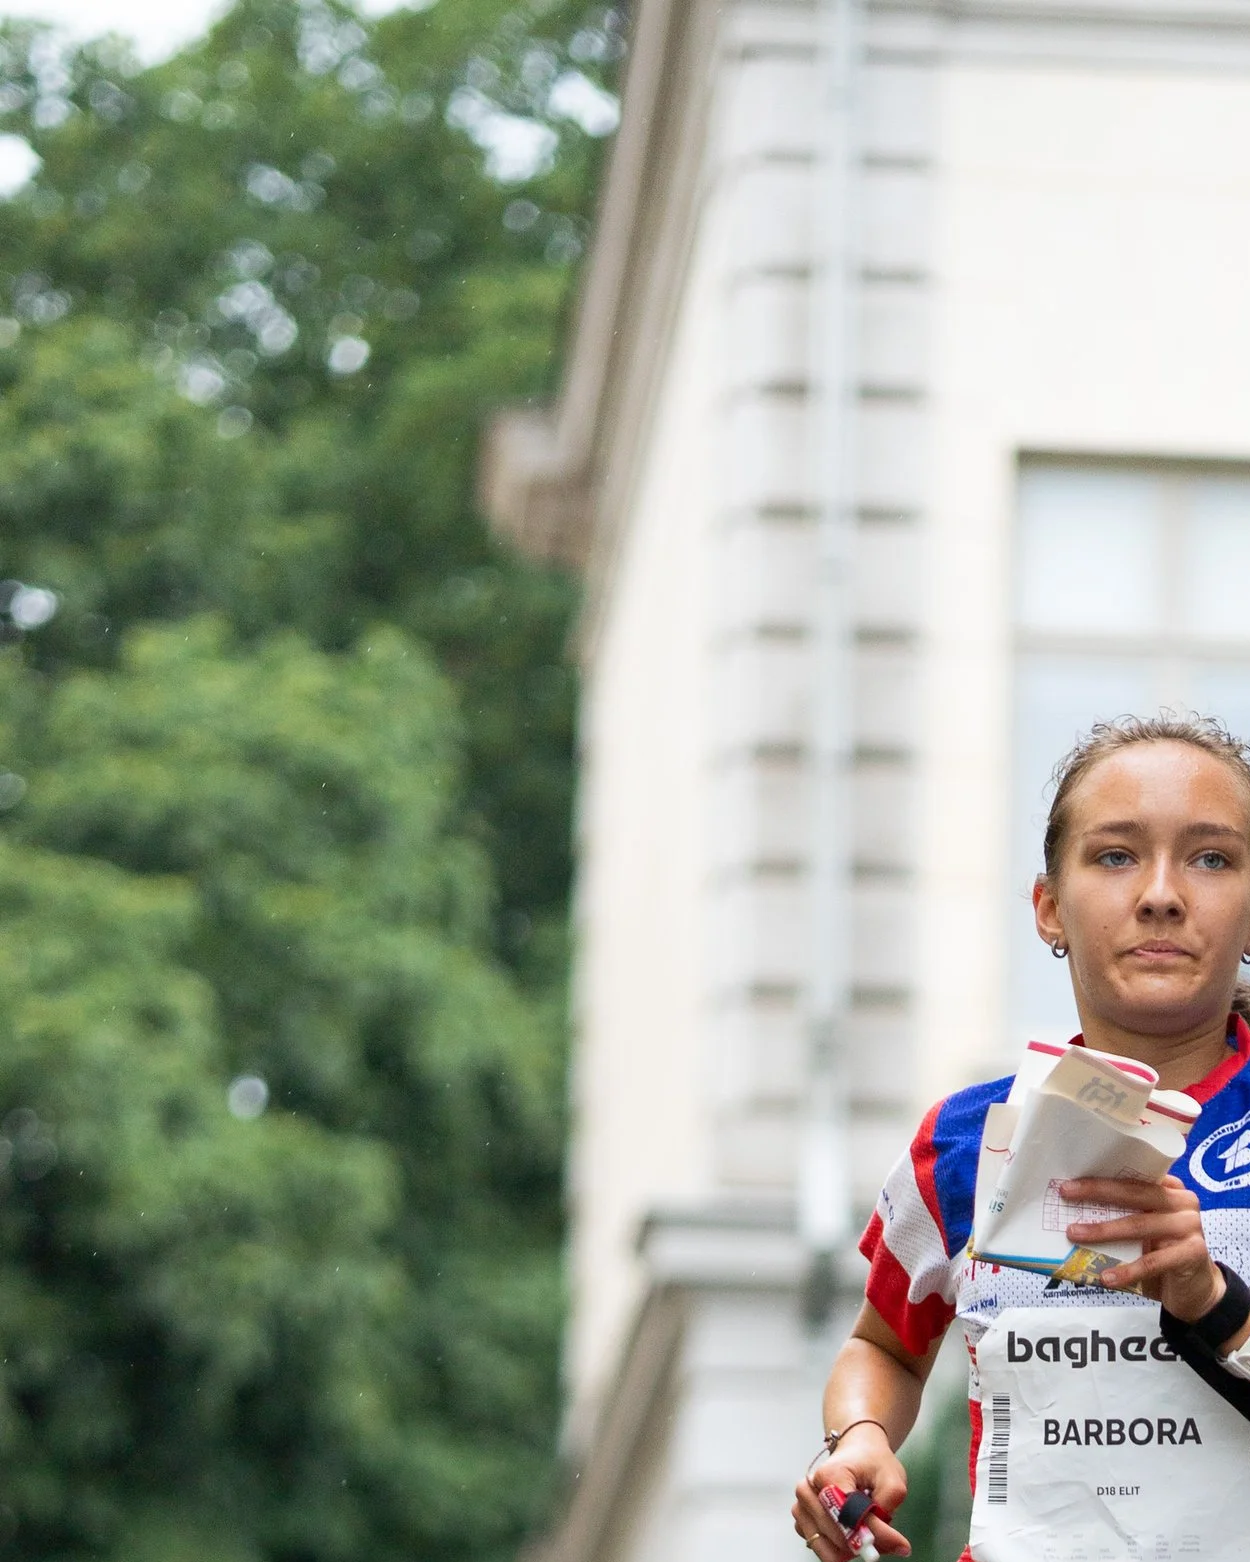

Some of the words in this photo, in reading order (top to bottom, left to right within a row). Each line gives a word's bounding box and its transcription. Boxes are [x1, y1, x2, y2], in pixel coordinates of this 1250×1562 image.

[1007, 1329, 1185, 1369] baghee
[1043, 1417, 1203, 1446] BARBORA
[1096, 1486, 1117, 1496] D18
[1119, 1486, 1141, 1496] ELIT
